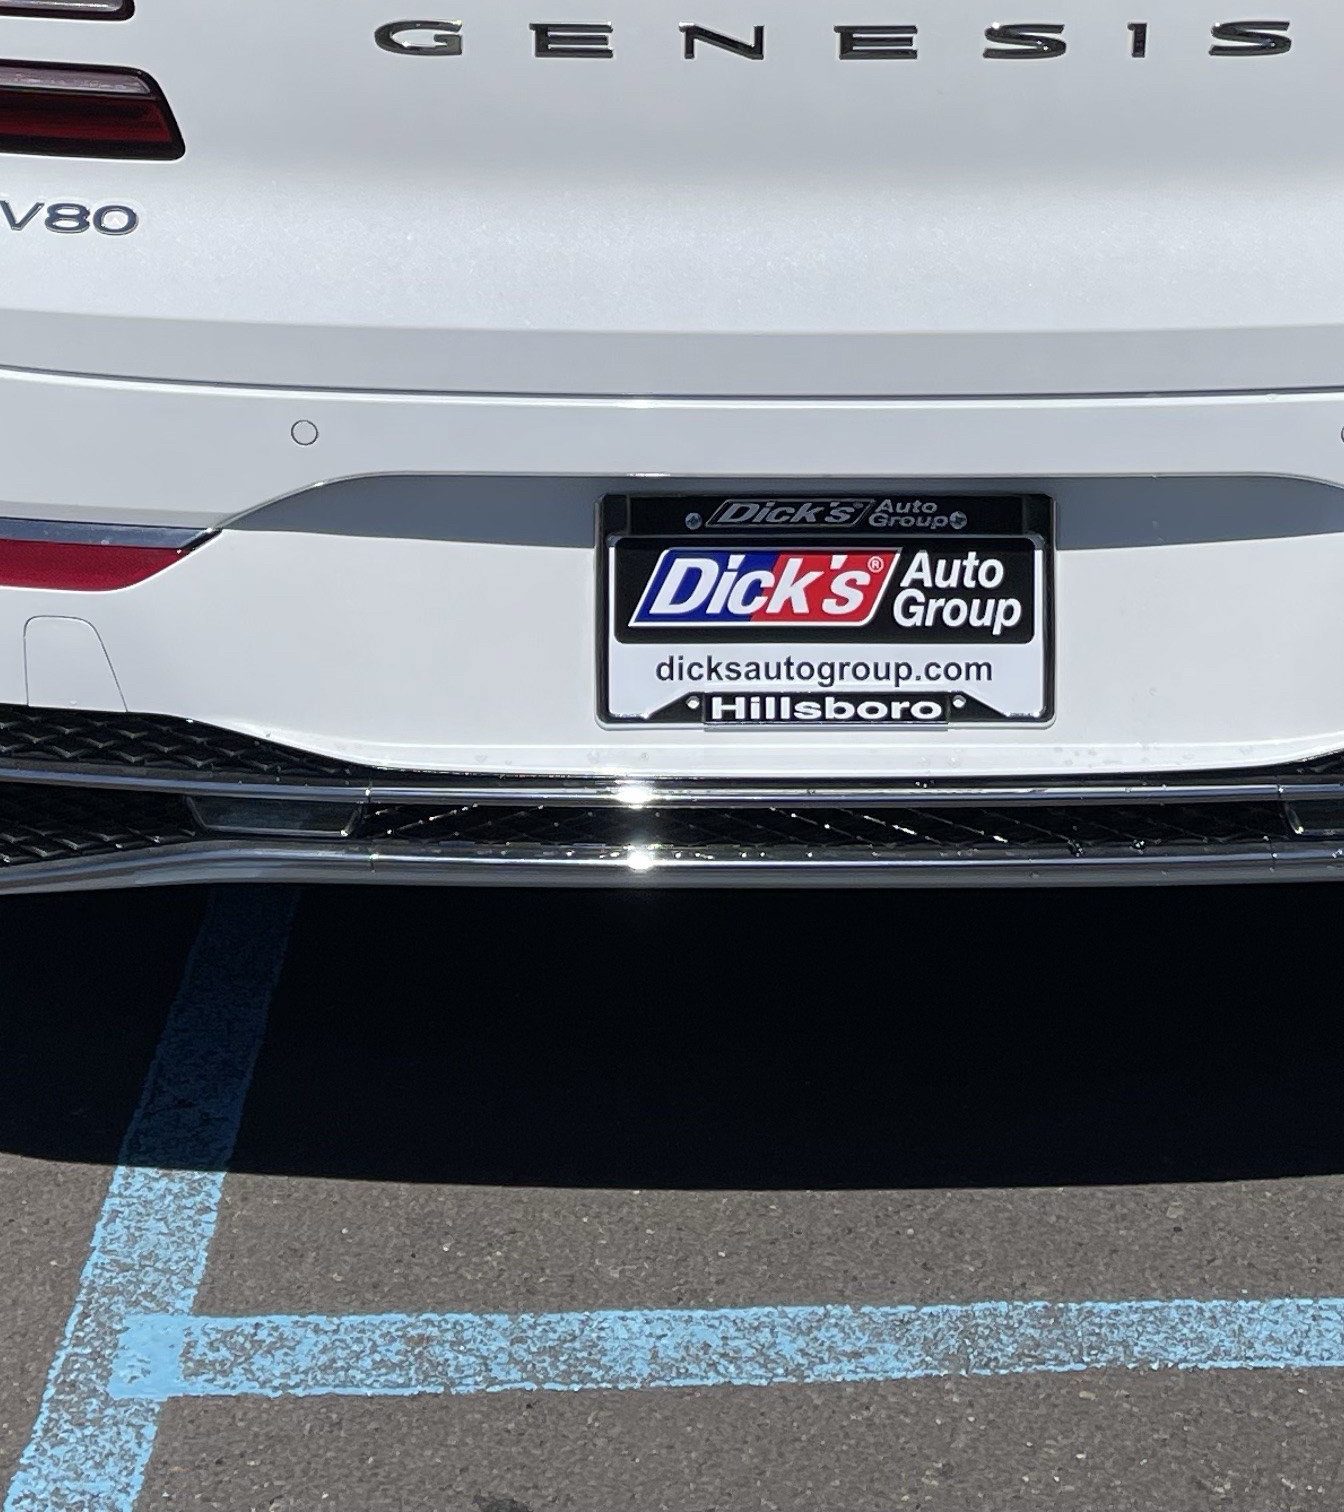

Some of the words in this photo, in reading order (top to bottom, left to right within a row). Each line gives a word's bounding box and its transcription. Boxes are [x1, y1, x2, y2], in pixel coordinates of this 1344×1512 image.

[373, 19, 1293, 60] GENESIS
[717, 501, 857, 524] Dick's
[873, 498, 939, 514] Auto
[867, 513, 951, 529] Group
[900, 549, 1004, 588] Auto
[892, 589, 1021, 635] Group
[655, 655, 993, 687] dicksautogroup.com
[710, 696, 943, 720] Hillsboro
